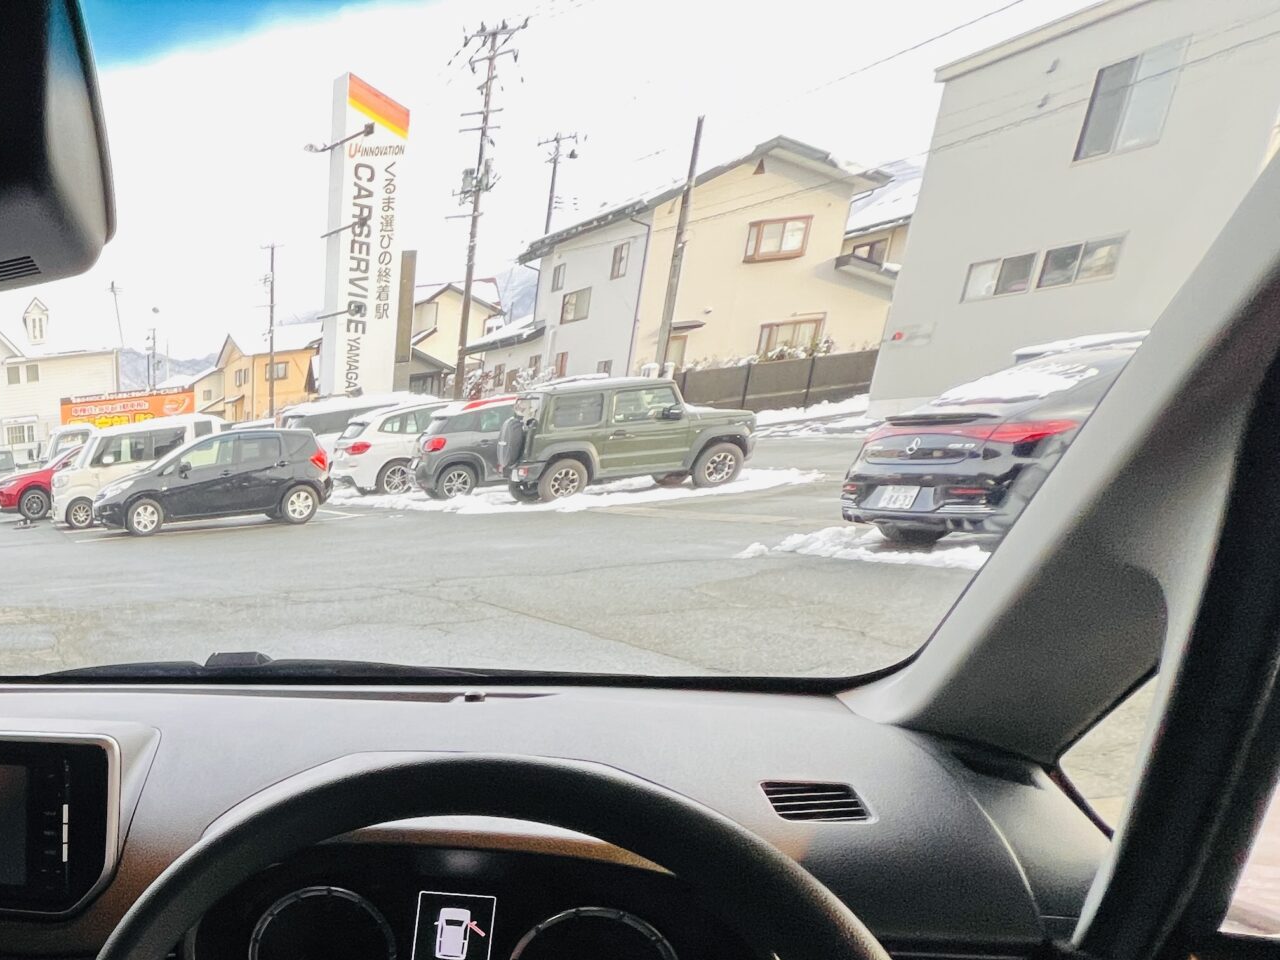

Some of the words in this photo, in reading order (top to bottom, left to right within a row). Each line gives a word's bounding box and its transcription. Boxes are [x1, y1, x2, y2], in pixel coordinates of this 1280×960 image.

[374, 160, 397, 320] くるま選びの終着駅
